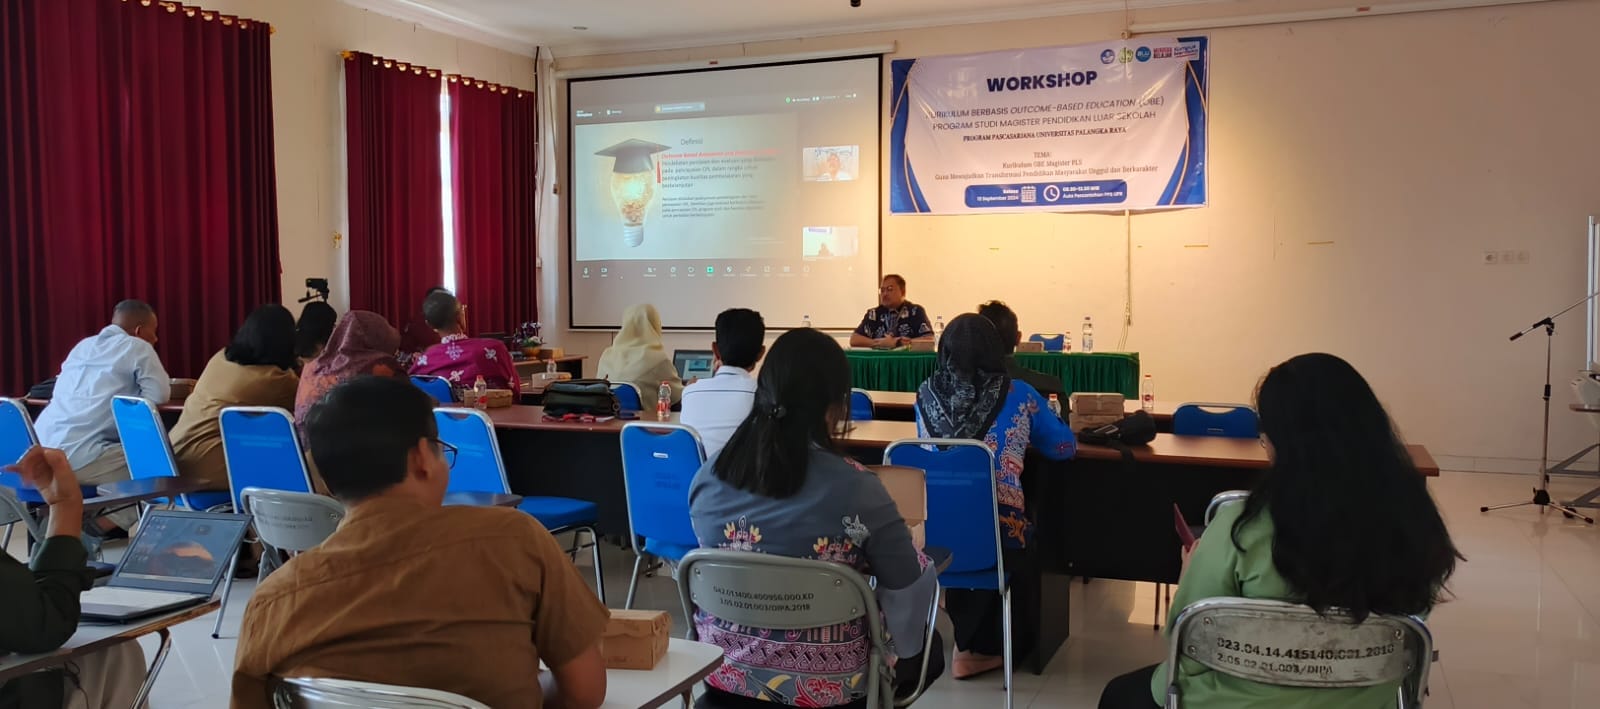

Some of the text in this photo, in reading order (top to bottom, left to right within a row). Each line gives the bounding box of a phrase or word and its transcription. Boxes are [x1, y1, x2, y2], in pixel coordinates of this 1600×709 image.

[987, 71, 1098, 92] WORKSHOP
[926, 109, 969, 119] URIKULUM
[971, 107, 1008, 117] BERBASIS
[1010, 102, 1083, 115] OUTCOME-BASED
[1085, 98, 1136, 110] EDUCATION
[933, 111, 1156, 131] PROGRAM STUDI MAGISTER PENDIDIKAN LUAR SEKOLAH
[963, 134, 991, 142] PROGRAM
[1036, 130, 1074, 138] UNIVERSITAS
[1075, 128, 1108, 136] PALANGKA
[1109, 126, 1127, 134] RAYA
